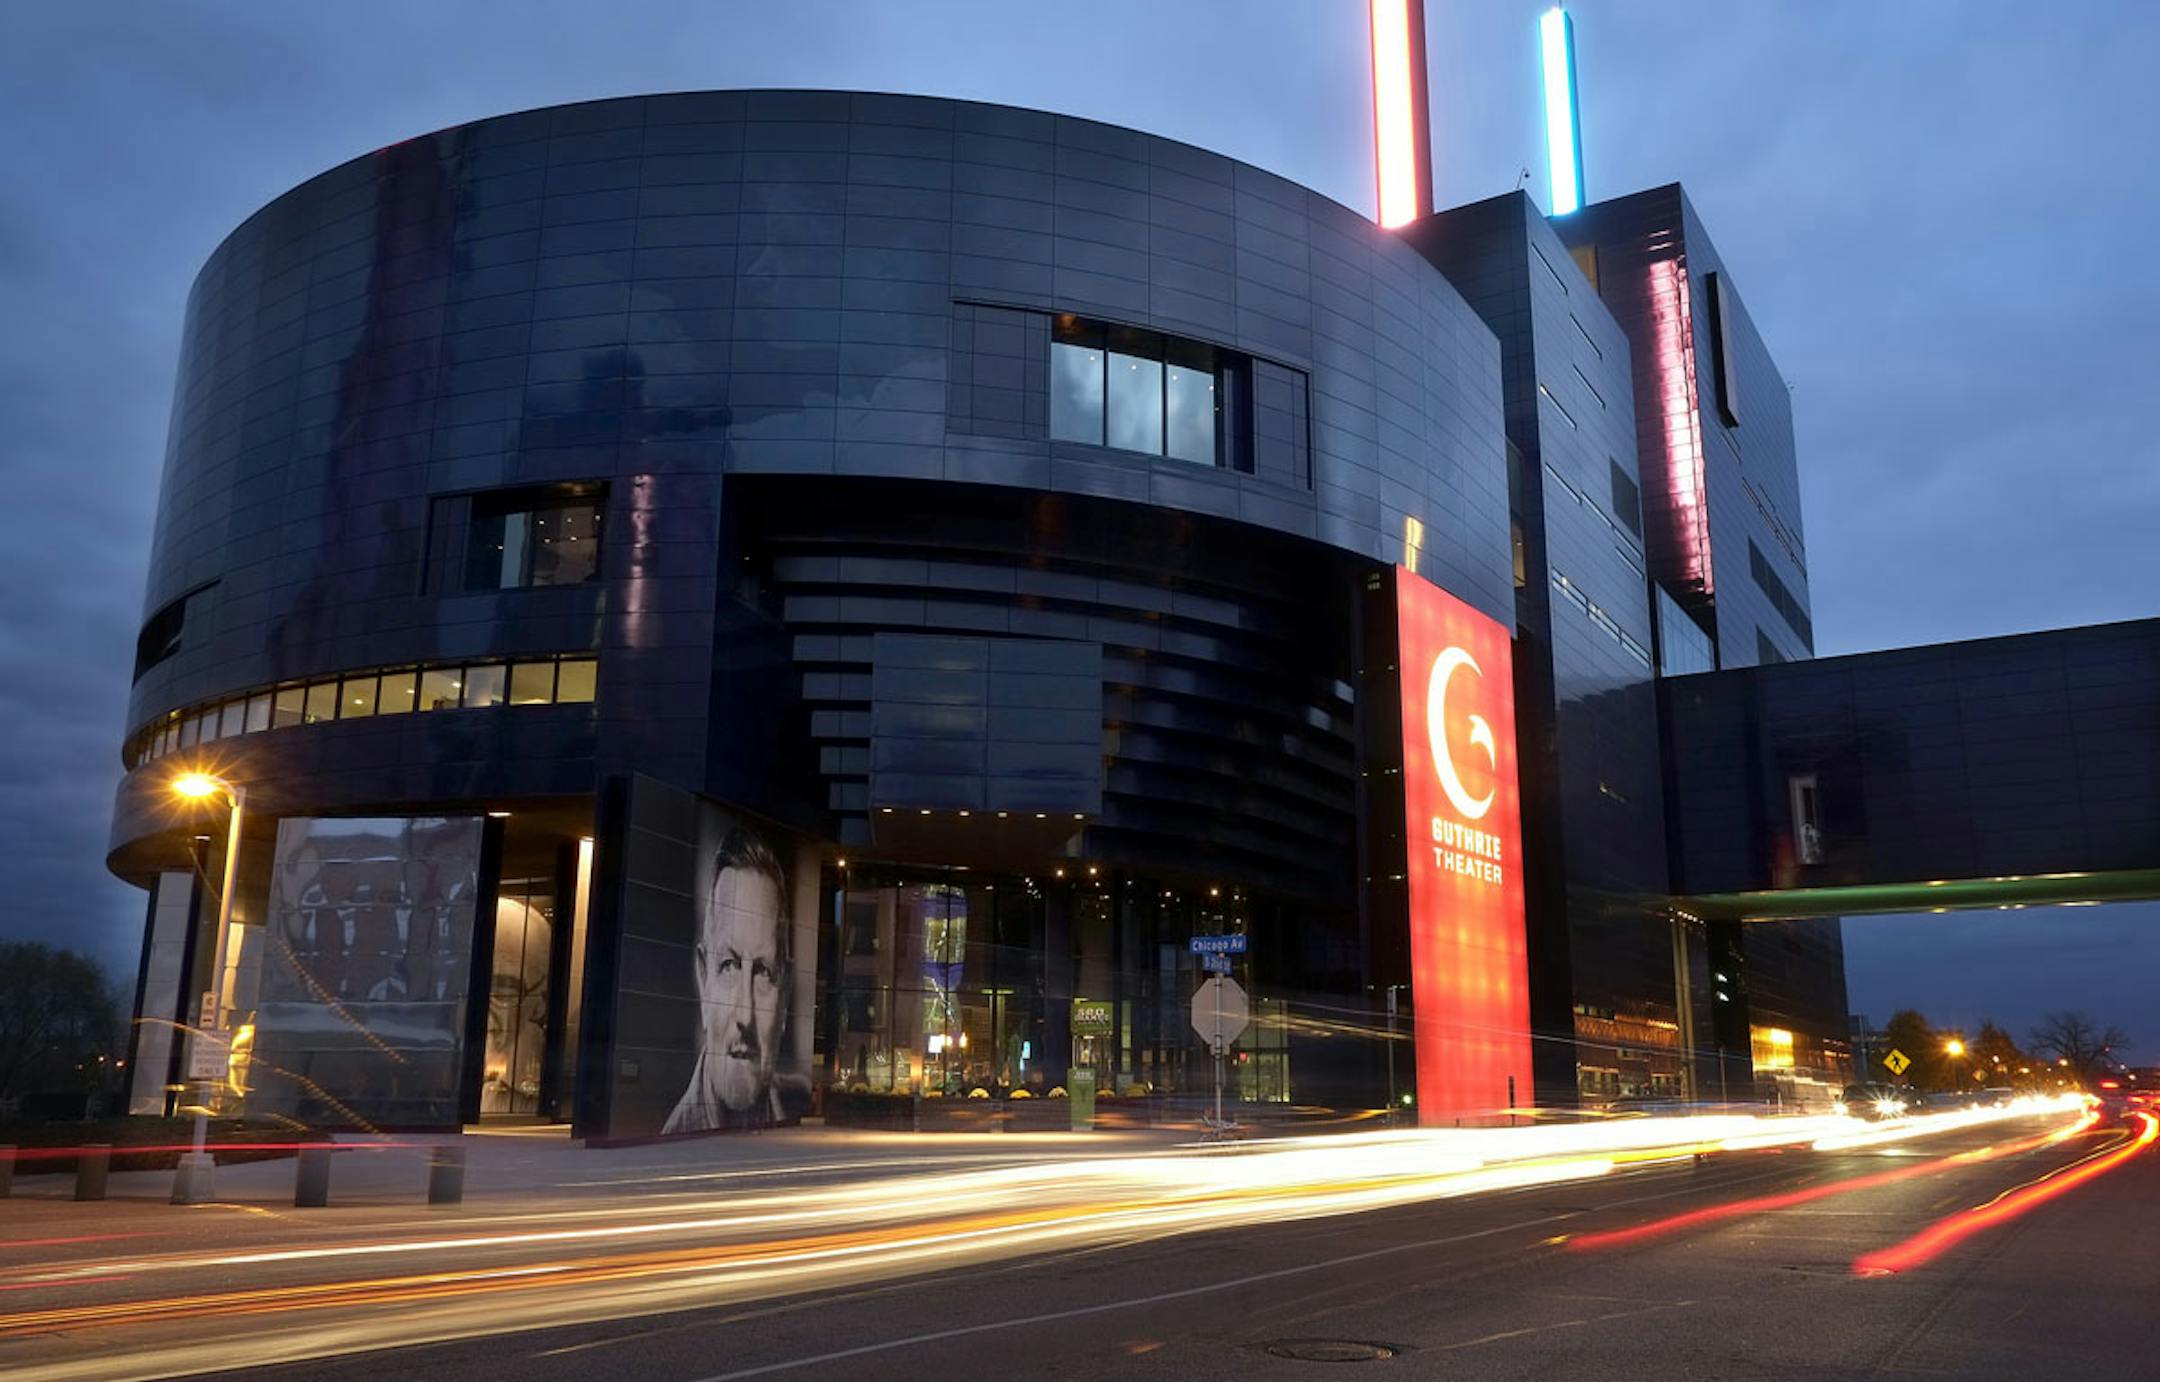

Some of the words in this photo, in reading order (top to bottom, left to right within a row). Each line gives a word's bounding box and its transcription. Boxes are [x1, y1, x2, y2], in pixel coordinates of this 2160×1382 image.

[1431, 816, 1502, 862] GUTHRIE
[1432, 846, 1503, 886] THEATER
[1192, 940, 1229, 952] Chicago
